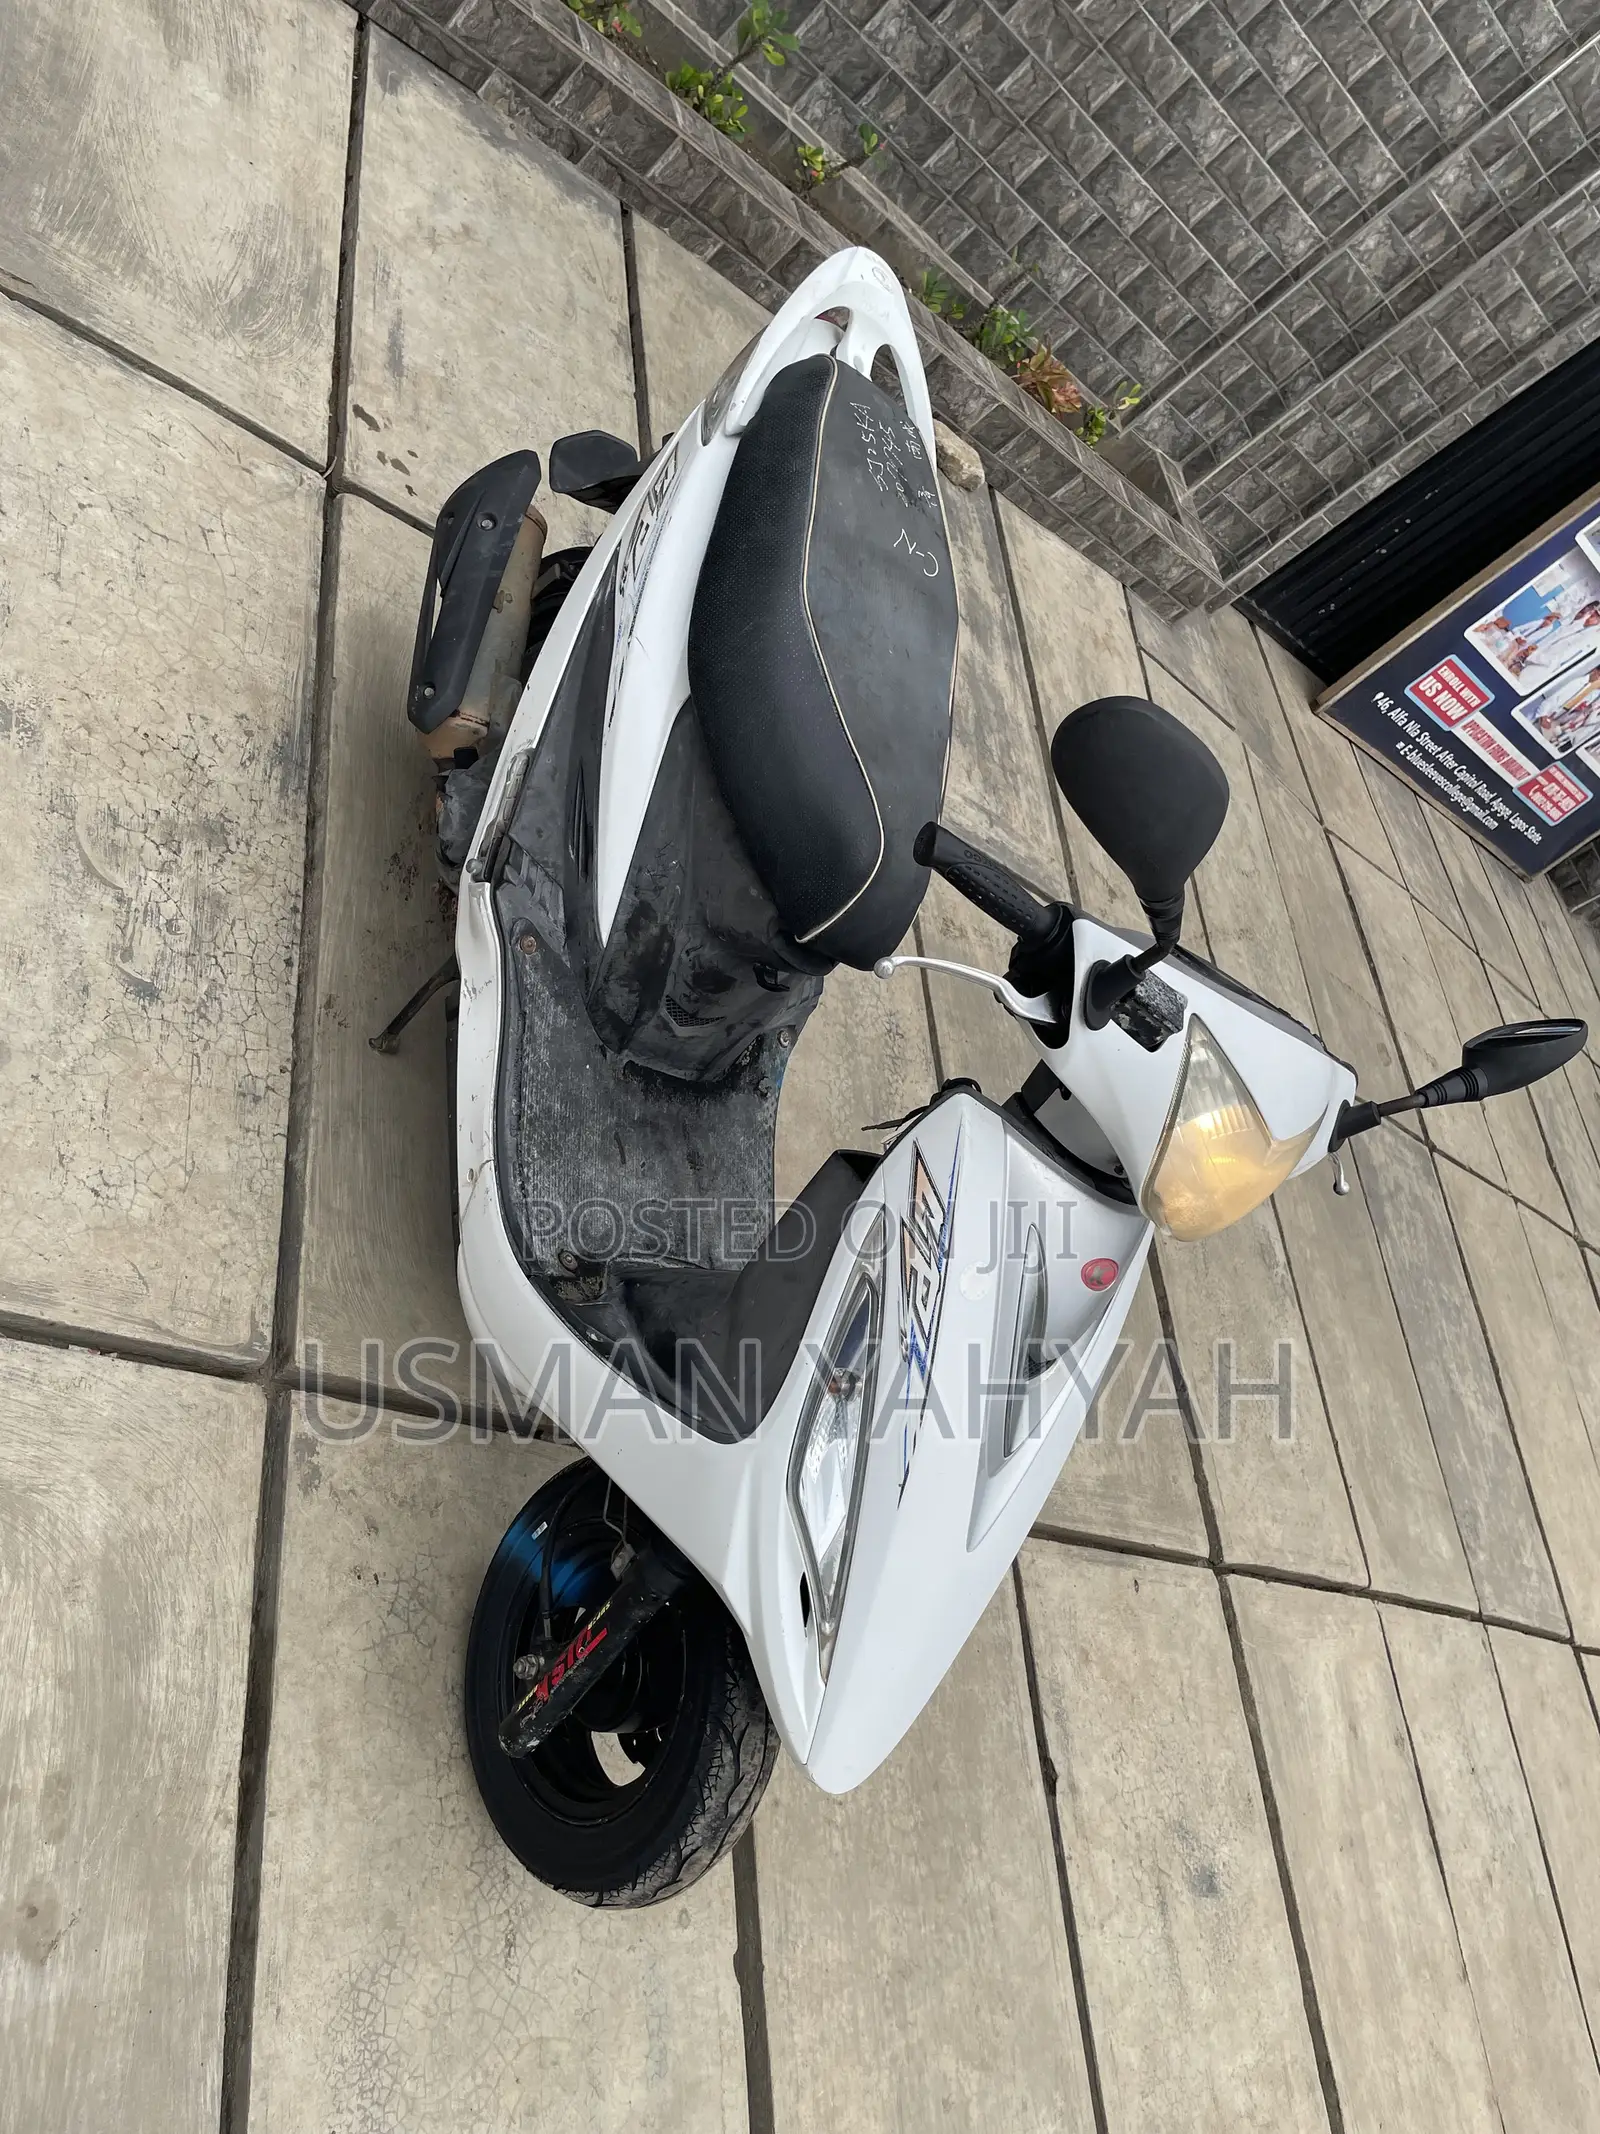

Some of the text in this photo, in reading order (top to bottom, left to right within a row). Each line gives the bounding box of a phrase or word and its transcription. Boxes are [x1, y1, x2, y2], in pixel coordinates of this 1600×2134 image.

[1418, 675, 1468, 720] US NOW
[1437, 665, 1481, 707] ENROLL WITH
[1376, 696, 1394, 714] 46,
[1386, 707, 1408, 726] Alfa
[1402, 719, 1421, 737] Nla
[1415, 731, 1442, 755] Street
[1434, 750, 1458, 769] After
[1453, 765, 1483, 789] Capitol
[1508, 812, 1529, 832] Lagos
